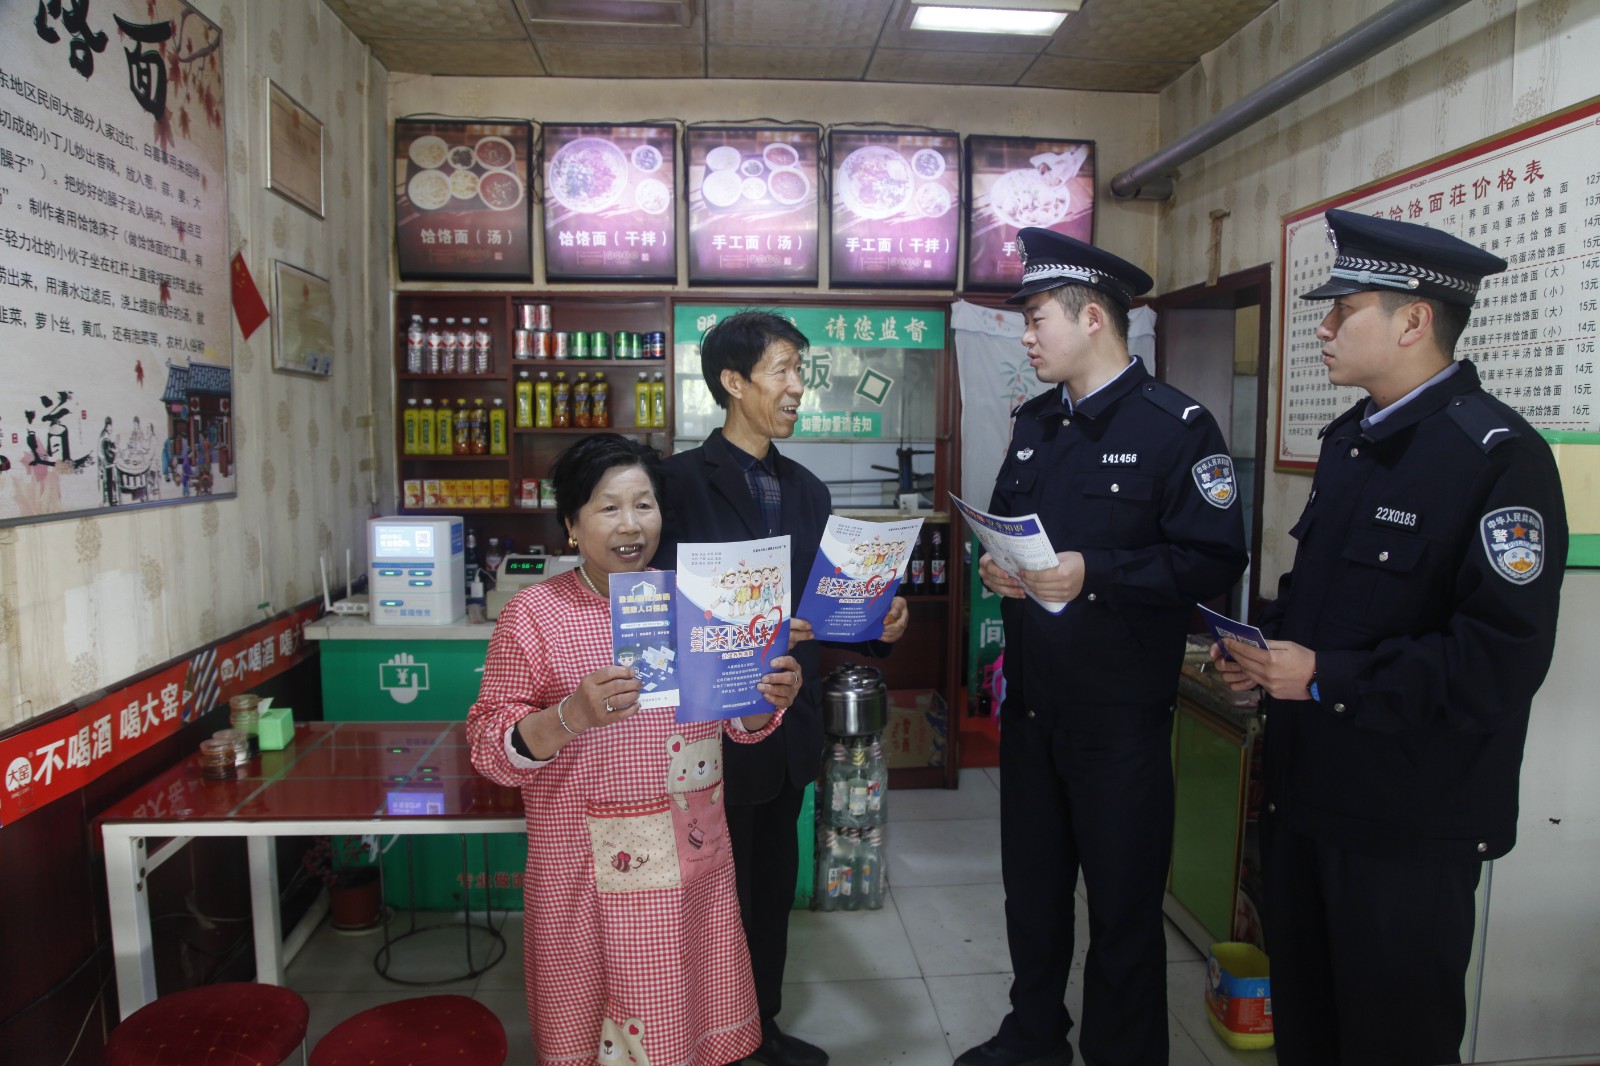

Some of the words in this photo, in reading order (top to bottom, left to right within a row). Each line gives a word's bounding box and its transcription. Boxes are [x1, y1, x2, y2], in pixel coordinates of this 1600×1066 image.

[420, 228, 513, 246] 饸饹面（汤）
[559, 230, 668, 248] 饸饹面（干拌）
[712, 234, 803, 251] 手工面（汤）
[845, 237, 952, 254] 手工面（干拌）
[1582, 257, 1600, 270] 14元
[1580, 278, 1599, 291] 13元
[1579, 299, 1598, 312] 15元
[825, 313, 928, 343] 请您监督
[1577, 320, 1596, 333] 14元
[1576, 341, 1594, 353] 13元
[1575, 362, 1593, 374] 14元
[1573, 383, 1592, 395] 15元
[1572, 404, 1590, 416] 16元
[801, 414, 873, 433] 如需加量请告知
[1102, 453, 1137, 463] 141456
[1375, 506, 1417, 527] 22X0183
[234, 635, 275, 681] 不喝酒
[33, 714, 112, 786] 不喝酒
[119, 682, 179, 741] 喝大窑
